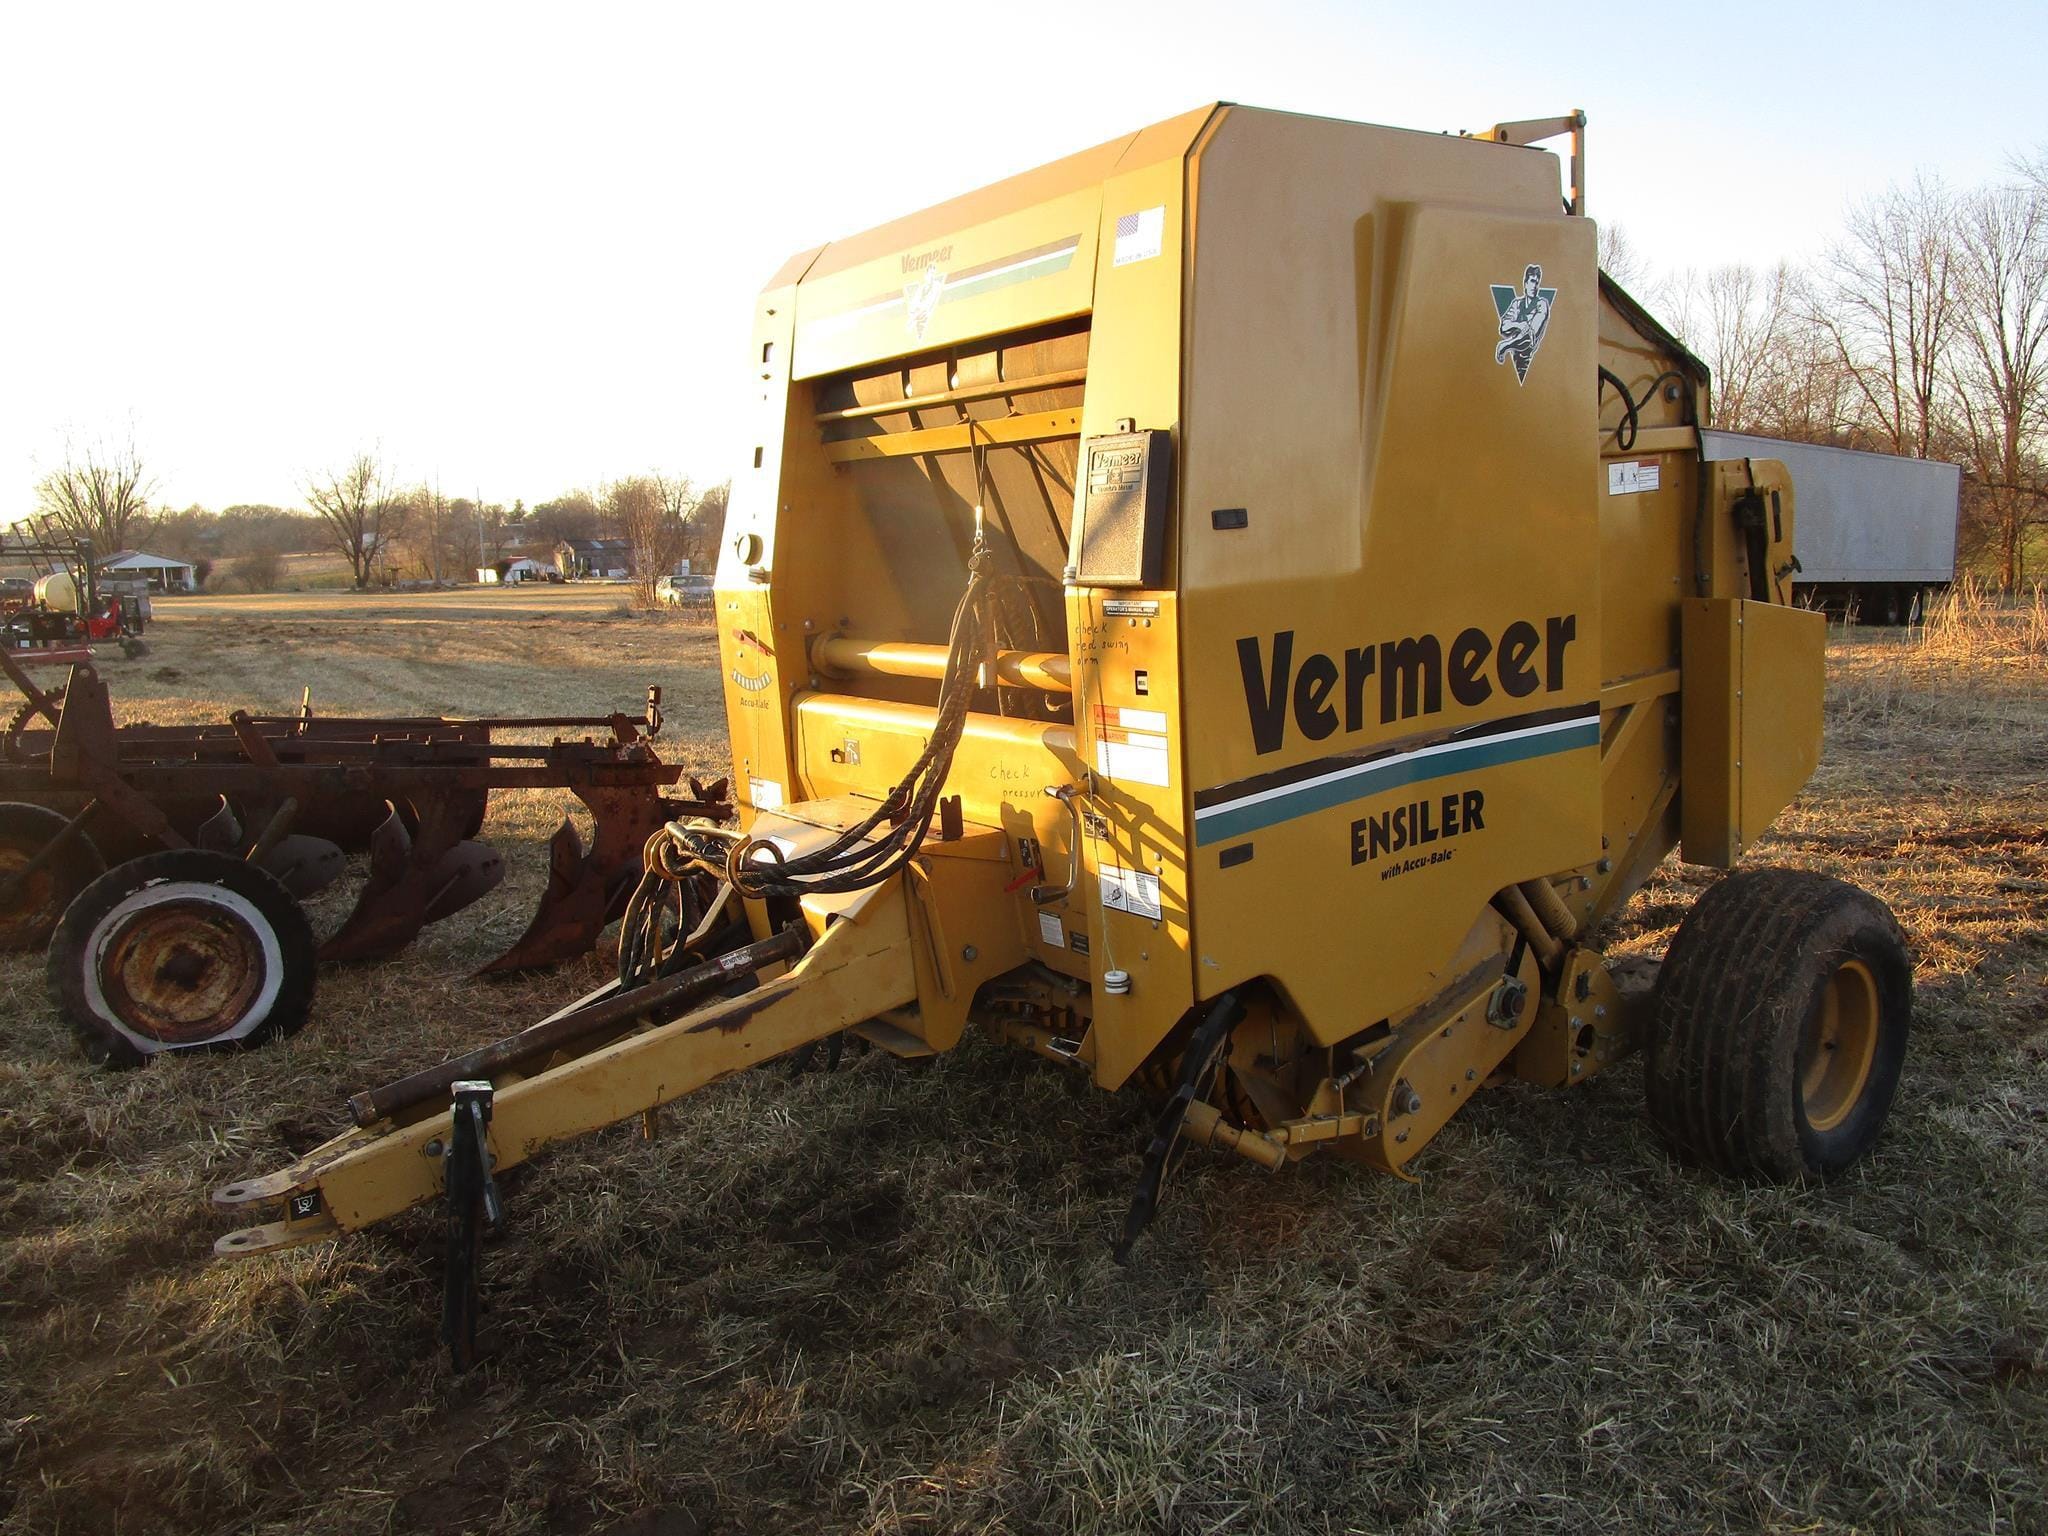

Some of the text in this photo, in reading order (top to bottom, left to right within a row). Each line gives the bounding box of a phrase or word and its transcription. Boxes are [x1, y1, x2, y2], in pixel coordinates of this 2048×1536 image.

[901, 245, 953, 274] Vermeer
[1096, 452, 1141, 469] Vermeer
[1102, 639, 1129, 655] swing
[1236, 614, 1576, 756] Vermeer
[1002, 788, 1043, 803] pressur
[1351, 789, 1485, 866] ENSILER
[1381, 863, 1401, 881] with
